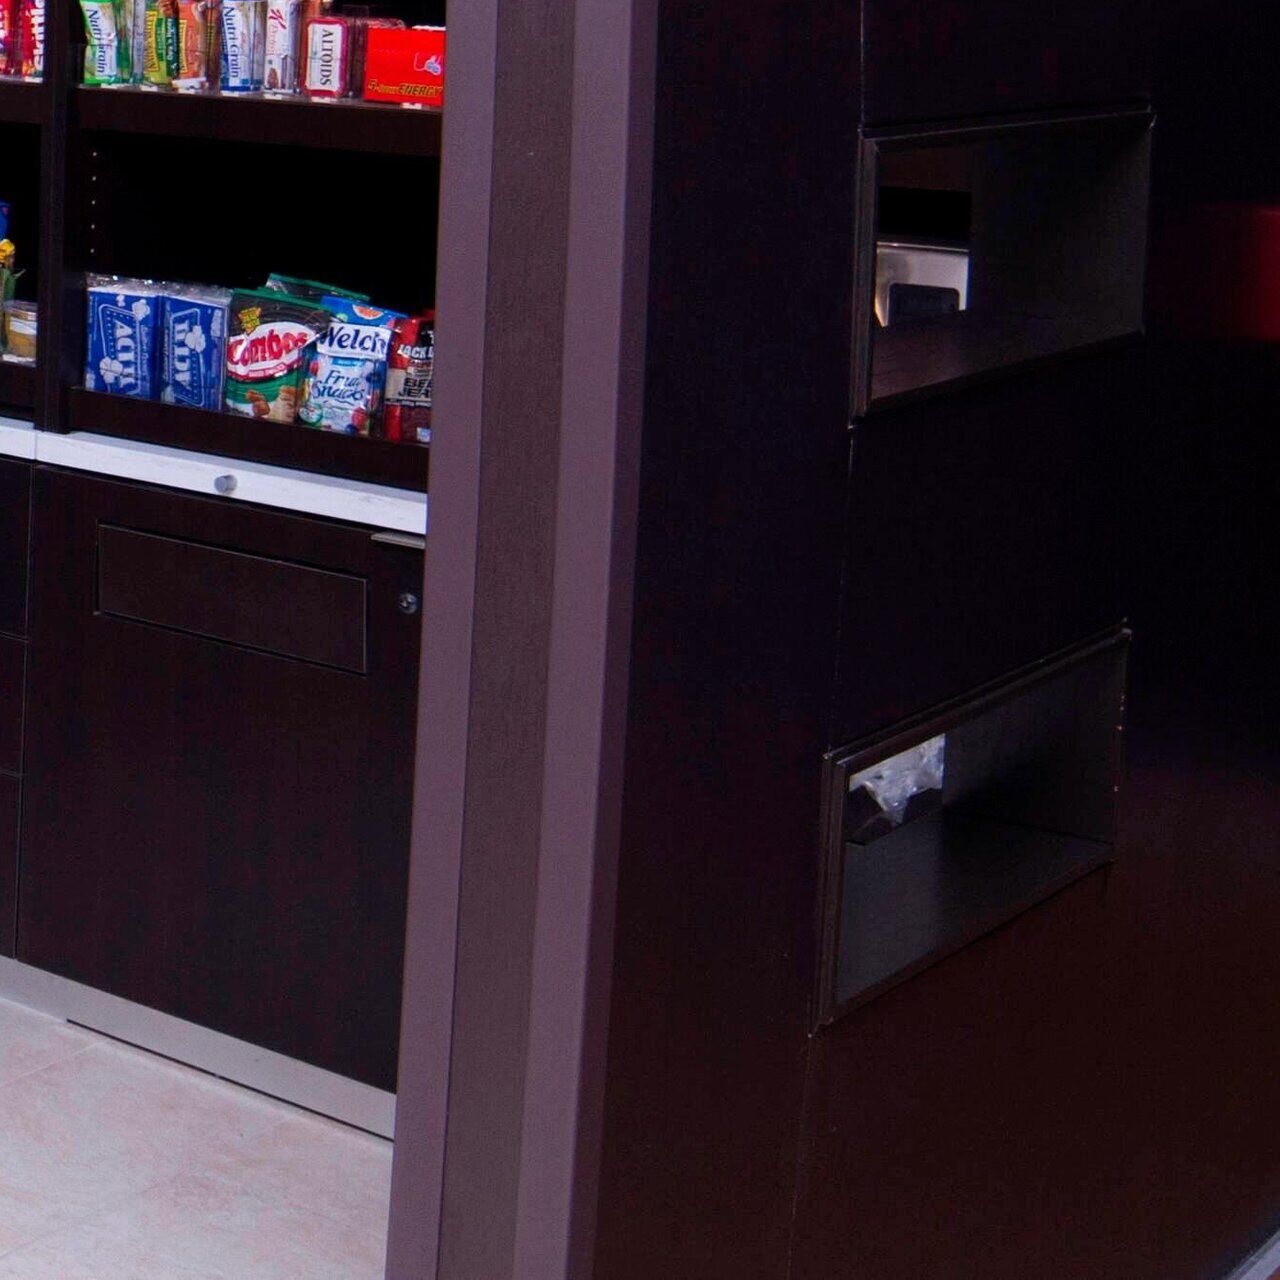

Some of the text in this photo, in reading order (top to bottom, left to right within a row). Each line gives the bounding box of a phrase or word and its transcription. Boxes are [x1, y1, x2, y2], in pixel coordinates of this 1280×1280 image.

[320, 29, 335, 87] ALTOIDS
[113, 320, 135, 362] ACT
[227, 329, 308, 367] Combos
